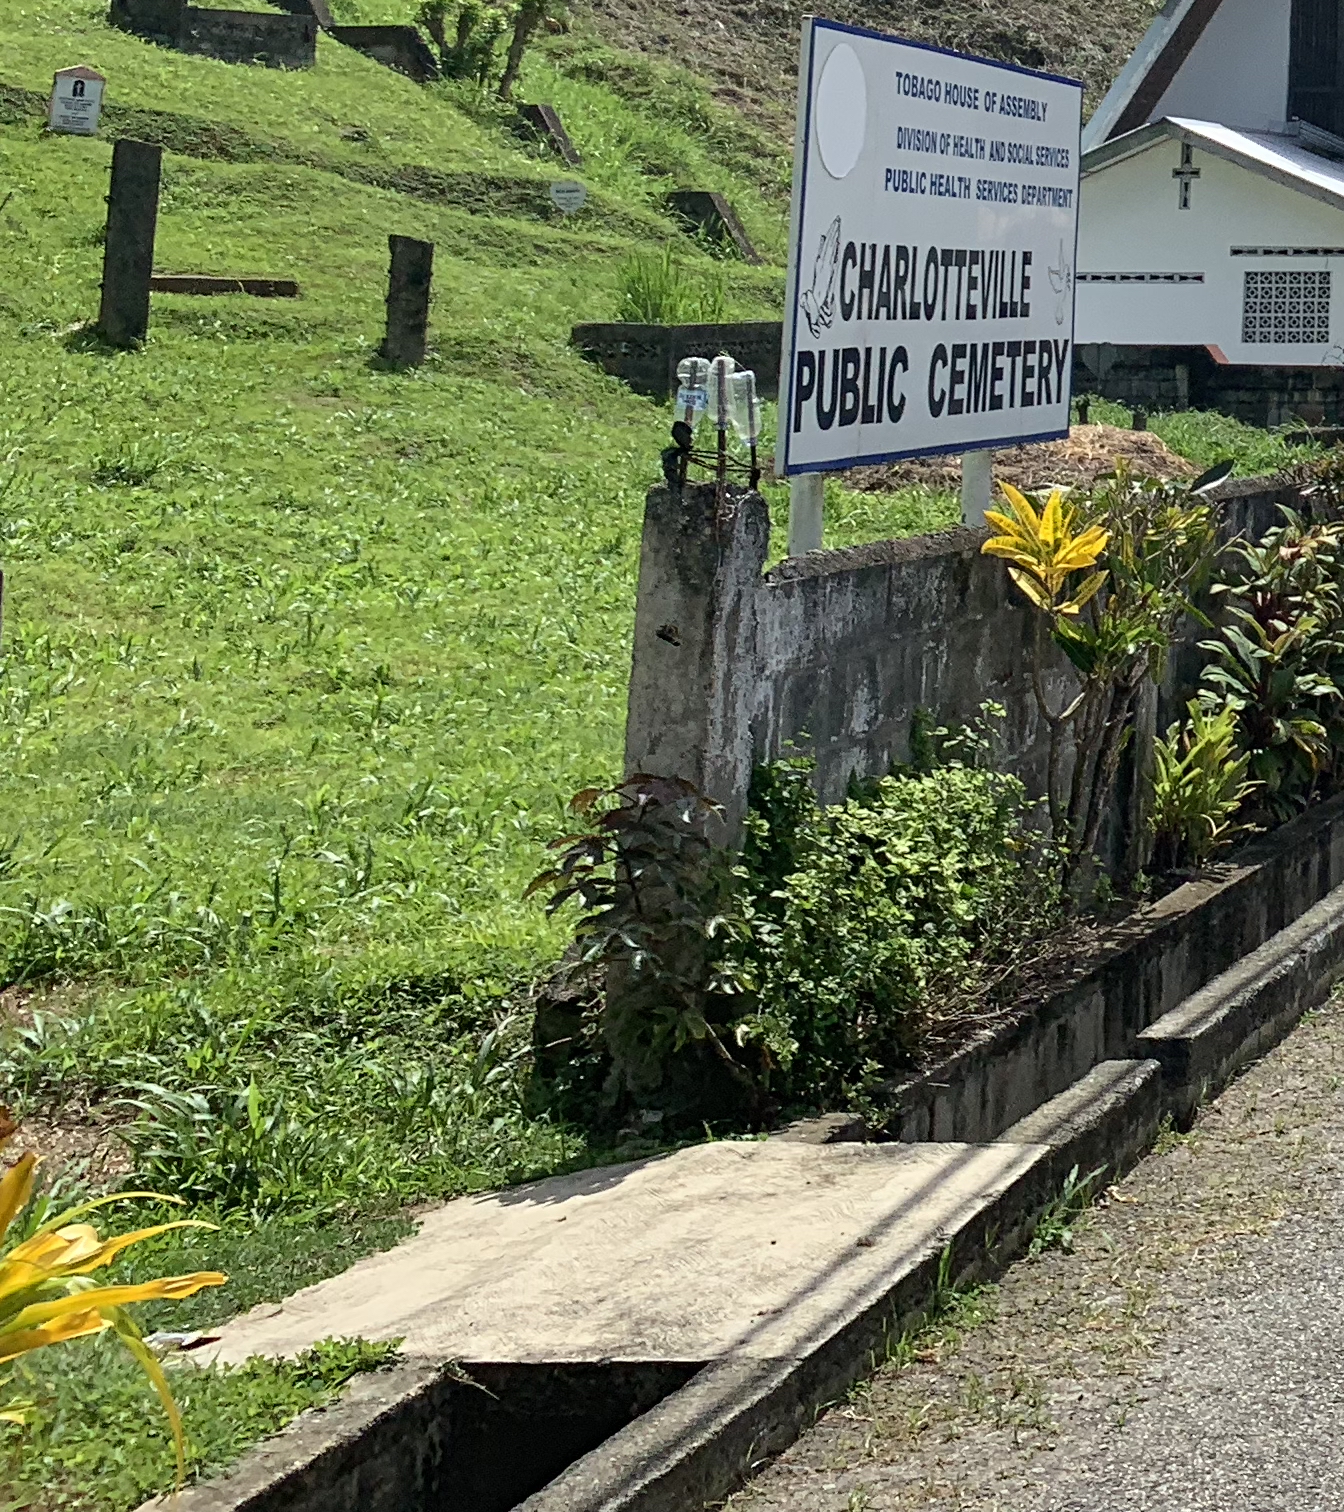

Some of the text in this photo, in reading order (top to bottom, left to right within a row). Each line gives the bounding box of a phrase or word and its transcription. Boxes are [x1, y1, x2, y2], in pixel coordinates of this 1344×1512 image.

[895, 71, 1048, 122] TOBAGO HOUSE OF ASSEMBLY
[897, 126, 1071, 168] DIVISION OF HEALTH AND SOCIAL SERVICES
[885, 168, 1074, 208] PUBLIC HEALTH SERVICES DEPARTMENT
[840, 241, 1033, 322] CHARLOTTEVILLE
[793, 338, 1070, 434] PUBLIC CEMETERY
